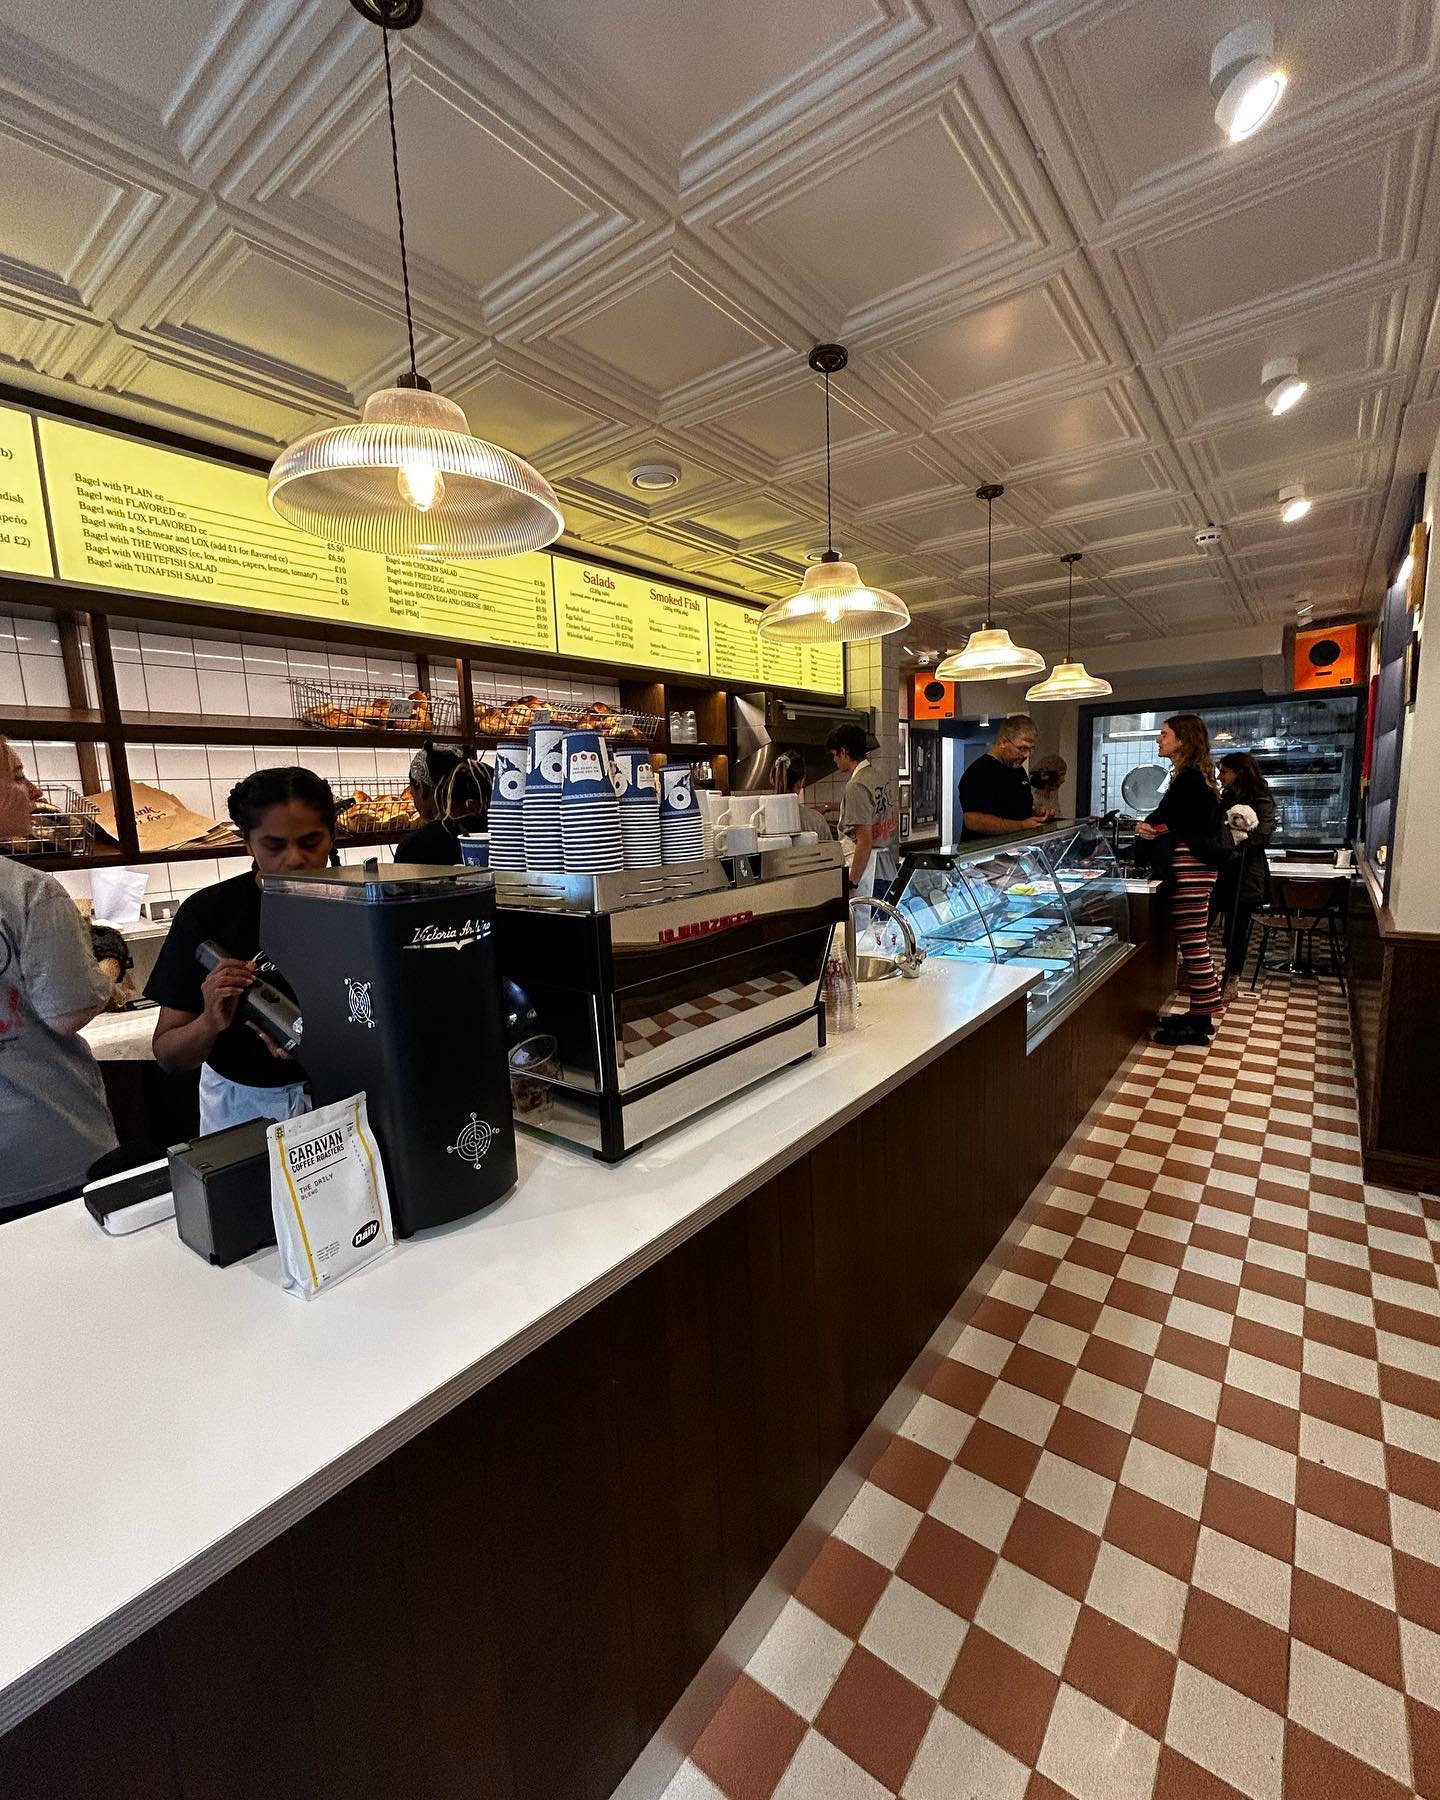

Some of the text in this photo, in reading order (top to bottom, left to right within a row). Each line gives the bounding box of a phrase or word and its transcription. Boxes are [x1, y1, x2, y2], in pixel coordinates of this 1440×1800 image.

[74, 472, 100, 487] Bagel
[102, 480, 122, 492] with
[124, 484, 153, 498] PLAIN
[76, 486, 344, 553] Bagel with FLAVORED cc £5.50
[14, 535, 31, 549] £2)
[78, 501, 345, 564] Bagel with LOX FLAVORED cc £6.50
[81, 514, 106, 528] Bagel
[108, 521, 128, 532] with
[129, 526, 135, 534] a
[136, 526, 173, 541] Schmear
[175, 535, 190, 544] and
[191, 537, 209, 548] LOX
[210, 540, 226, 552] (add
[228, 543, 237, 553] £1
[239, 546, 249, 555] for
[250, 549, 277, 561] flavored
[334, 564, 346, 574] £10
[83, 528, 108, 541] Bagel
[110, 534, 129, 545] with
[131, 537, 152, 549] THE
[153, 541, 188, 556] WORKS
[203, 552, 218, 562] lox,
[218, 556, 241, 566] onion,
[268, 564, 291, 575] lemon,
[335, 576, 347, 585] £13
[85, 542, 110, 555] Bagel
[112, 548, 131, 558] with
[133, 550, 187, 568] WHITEFISH
[188, 562, 217, 573] SALAD
[385, 555, 401, 566] Bagel
[401, 560, 413, 568] with
[413, 561, 439, 573] CHICKEN
[440, 568, 458, 577] SALAD
[87, 556, 112, 568] Bagel
[114, 561, 134, 571] with
[135, 563, 183, 580] TUNAFISH
[185, 573, 214, 584] SALAD
[386, 565, 401, 575] Bagel
[402, 569, 414, 577] with
[414, 571, 432, 581] FRIED
[432, 575, 445, 584] EGG
[583, 570, 616, 590] Salads
[387, 576, 402, 586] Bagel
[403, 579, 414, 588] with
[415, 581, 433, 590] FRIED
[433, 585, 445, 593] EGG
[446, 588, 457, 596] AND
[458, 590, 479, 600] CHEESE
[388, 586, 403, 595] Bagel
[404, 590, 415, 598] with
[415, 591, 436, 601] BACON
[436, 595, 448, 603] EGG
[448, 597, 460, 606] AND
[460, 599, 482, 609] CHEESE
[649, 588, 683, 607] Smoked
[684, 597, 700, 612] Fish
[389, 596, 404, 605] Bagel
[389, 606, 405, 616] Bagel
[411, 923, 457, 943] Victoria
[289, 1130, 343, 1165] CARAVAN
[291, 1143, 345, 1173] COFFEE ROASTERS
[299, 1172, 333, 1194] THE DAILY
[355, 1221, 378, 1246] Daily
